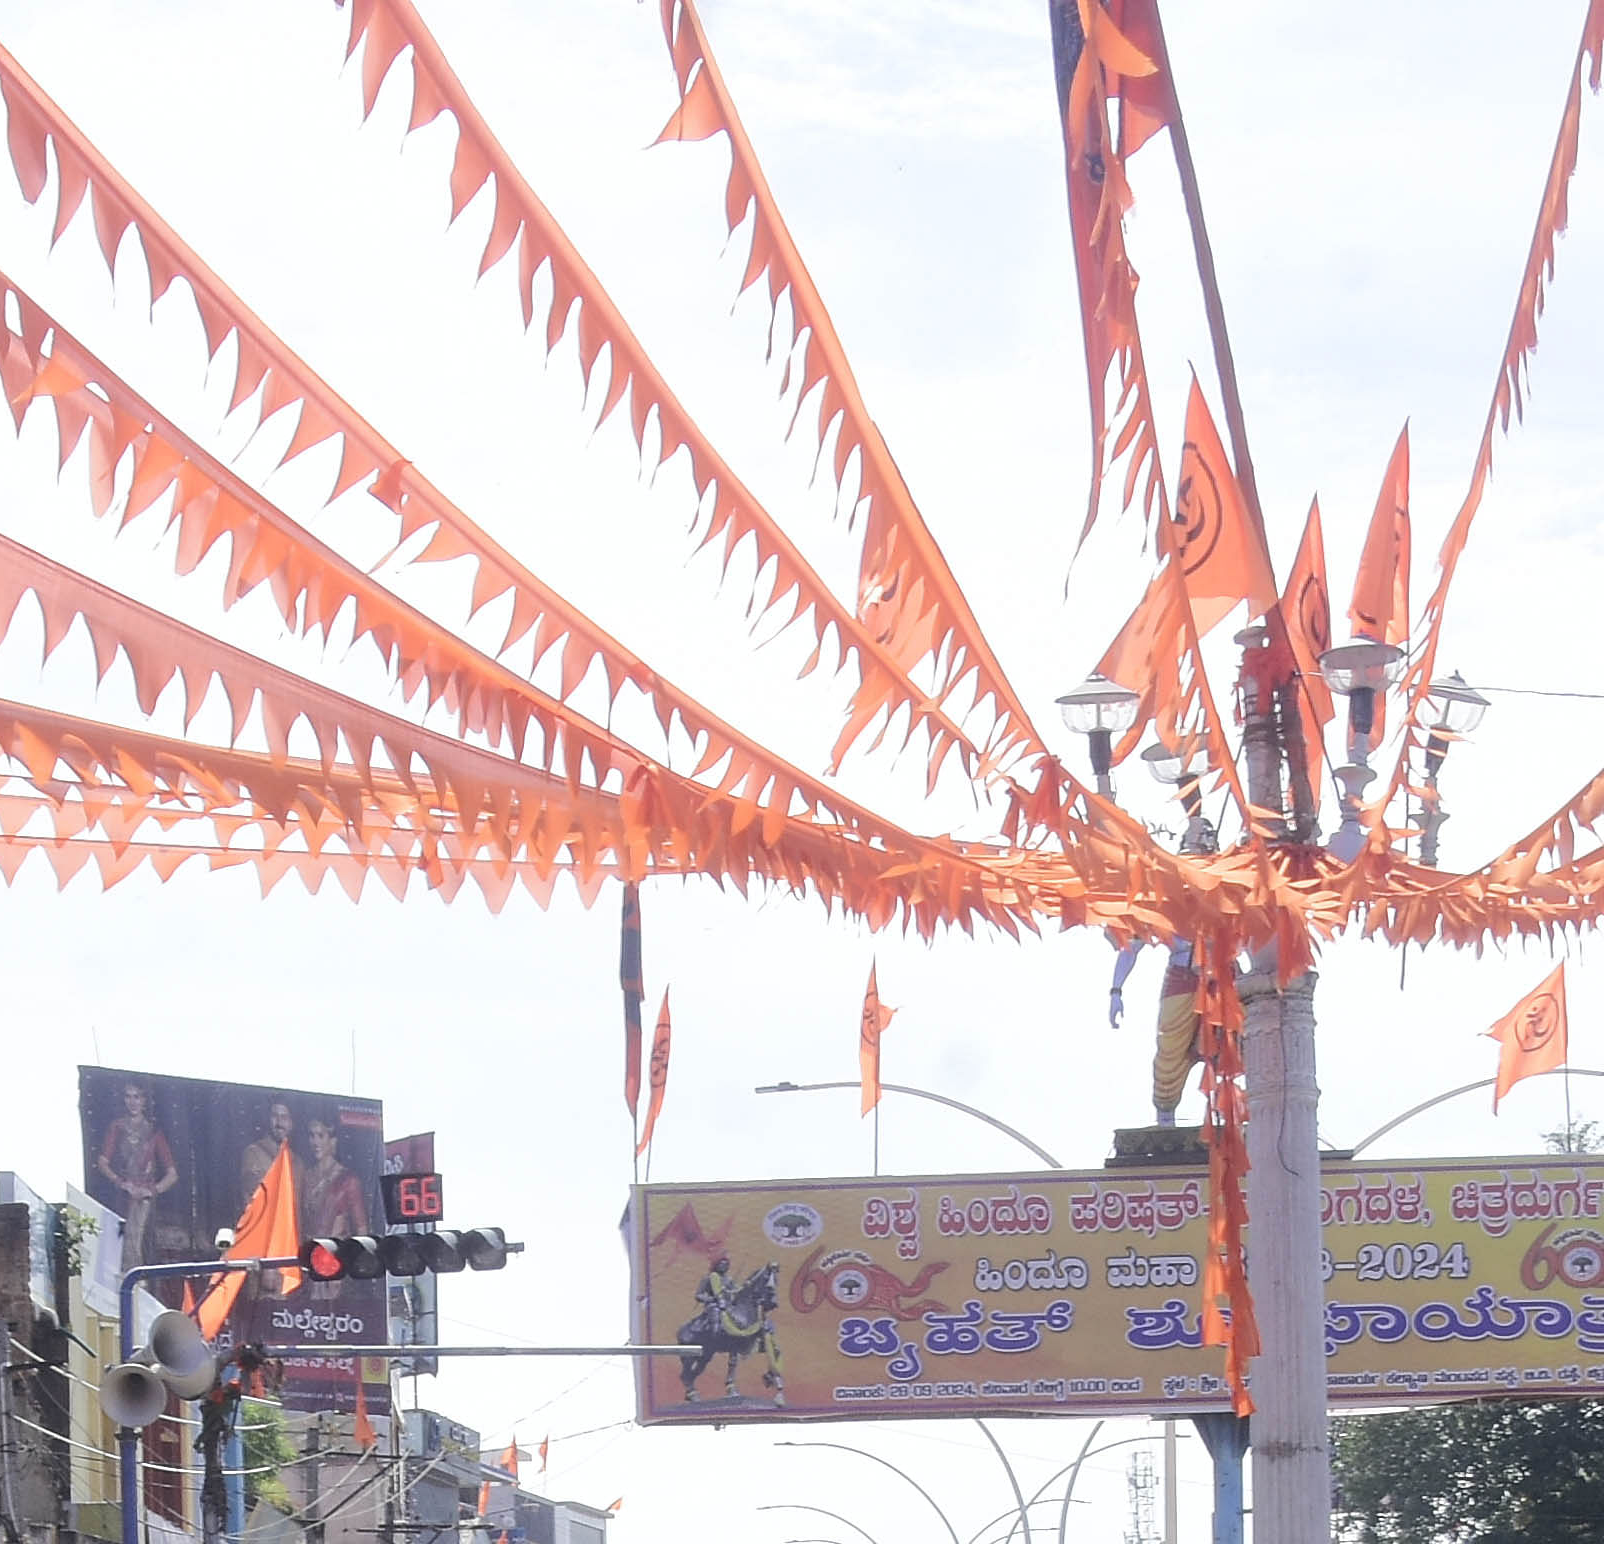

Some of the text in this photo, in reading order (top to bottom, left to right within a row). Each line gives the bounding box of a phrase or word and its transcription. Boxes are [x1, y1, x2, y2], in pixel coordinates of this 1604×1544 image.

[399, 1176, 441, 1216] 66
[862, 1188, 921, 1260] ವಿಶ್ವ
[937, 1185, 1052, 1236] ಹಿಂದೂ
[973, 1247, 1088, 1292] ಹಿಂದೂ
[1106, 1246, 1199, 1289] ಮಹಾ
[272, 1308, 364, 1340] ಮಲ್ಲೇಶ್ವರಂ
[836, 1299, 1075, 1381] ಬೃಹತ್
